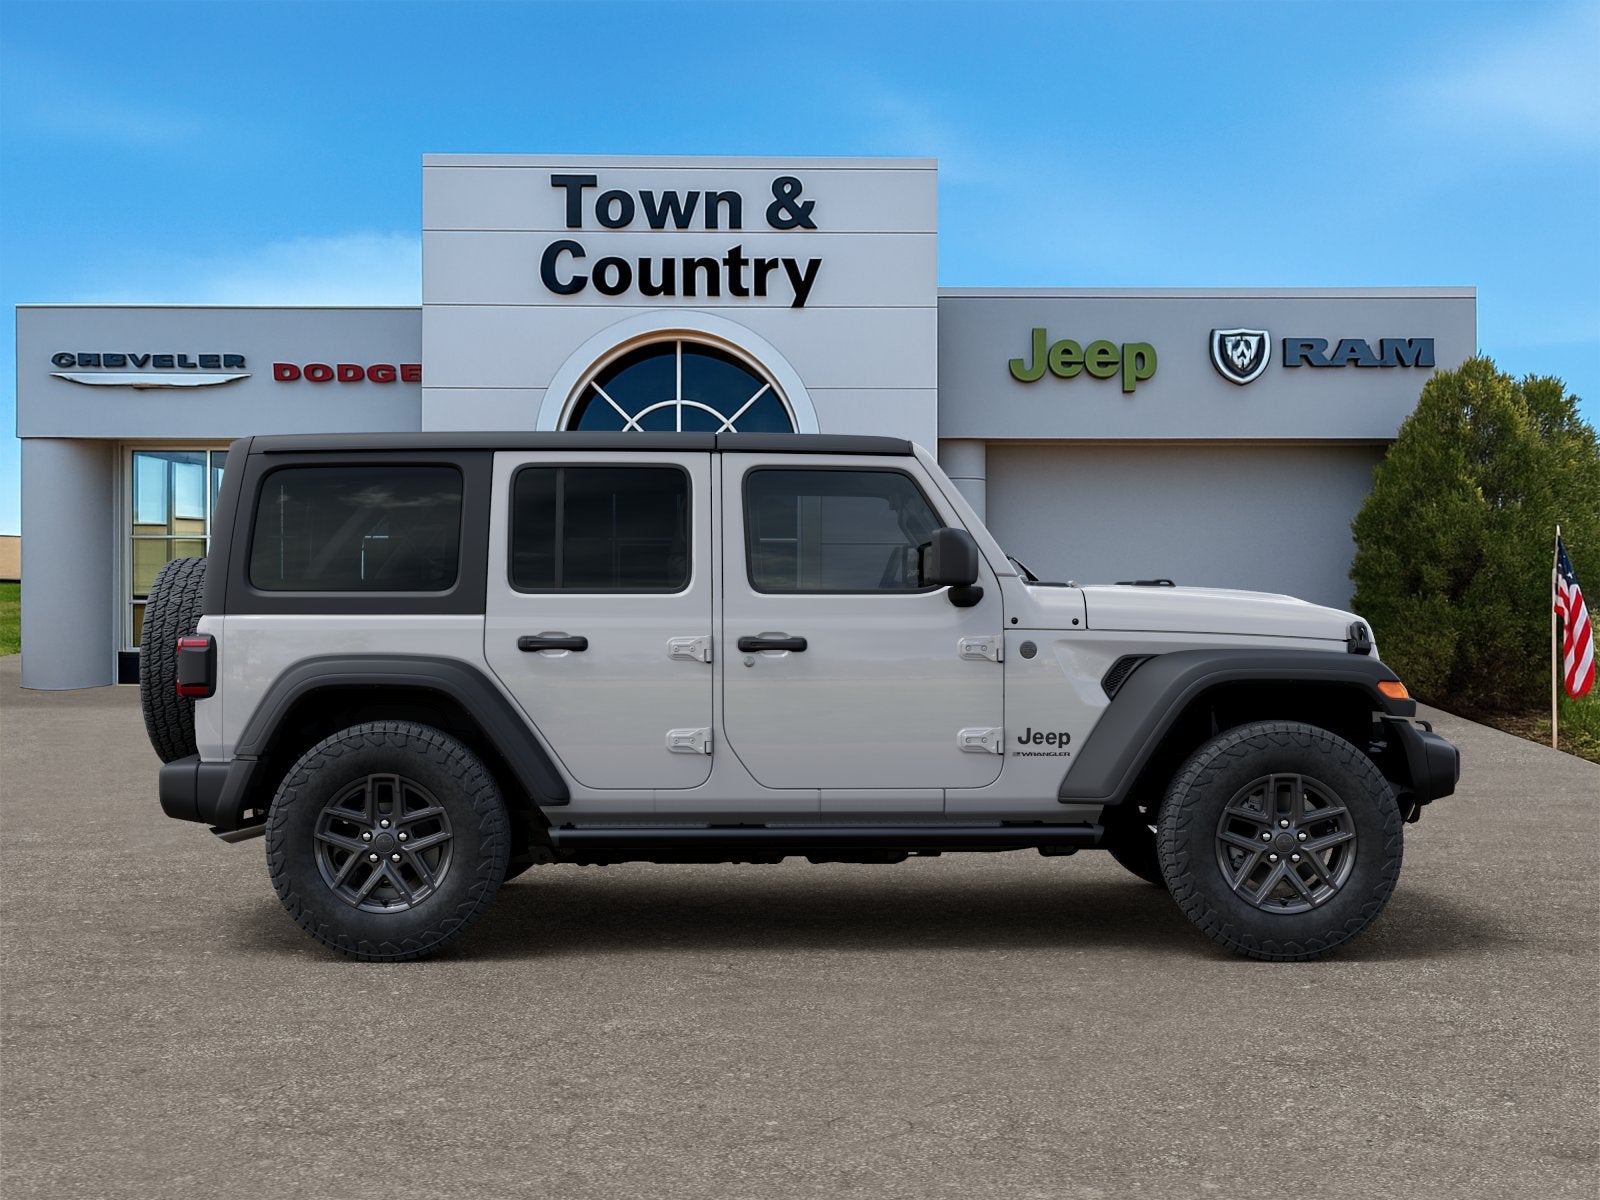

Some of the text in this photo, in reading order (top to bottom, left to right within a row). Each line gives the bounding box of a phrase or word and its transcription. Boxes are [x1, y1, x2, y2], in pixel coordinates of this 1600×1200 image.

[550, 174, 818, 230] Town &
[540, 239, 823, 308] Country
[273, 363, 422, 383] DODGE
[1009, 328, 1158, 393] Jeep
[1282, 338, 1436, 368] RAM
[1017, 727, 1071, 748] Jeep
